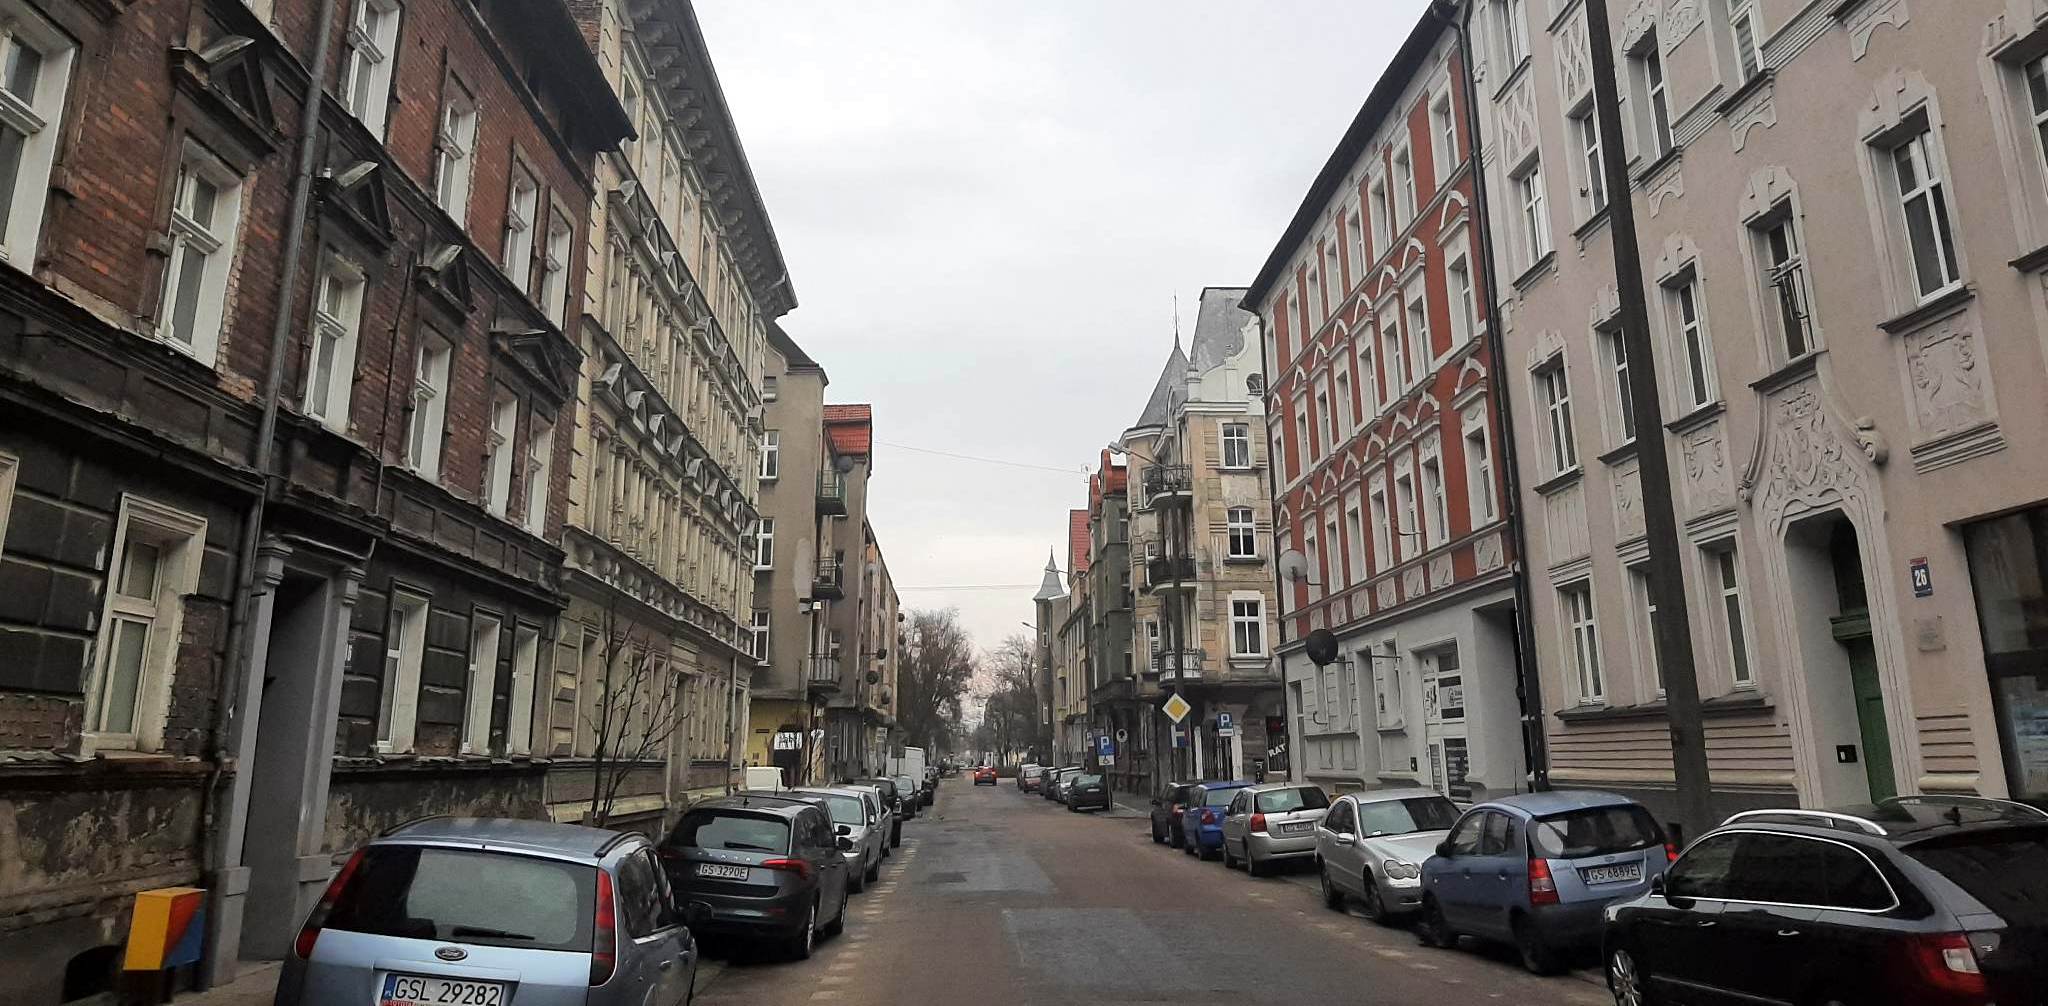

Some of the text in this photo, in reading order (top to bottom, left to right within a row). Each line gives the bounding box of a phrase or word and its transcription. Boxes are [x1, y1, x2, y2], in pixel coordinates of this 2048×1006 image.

[1914, 568, 1928, 587] 26
[1220, 713, 1230, 727] P
[1100, 736, 1110, 750] P
[701, 864, 714, 875] GS
[1591, 869, 1605, 880] GS
[394, 978, 499, 1006] GSL 29282
